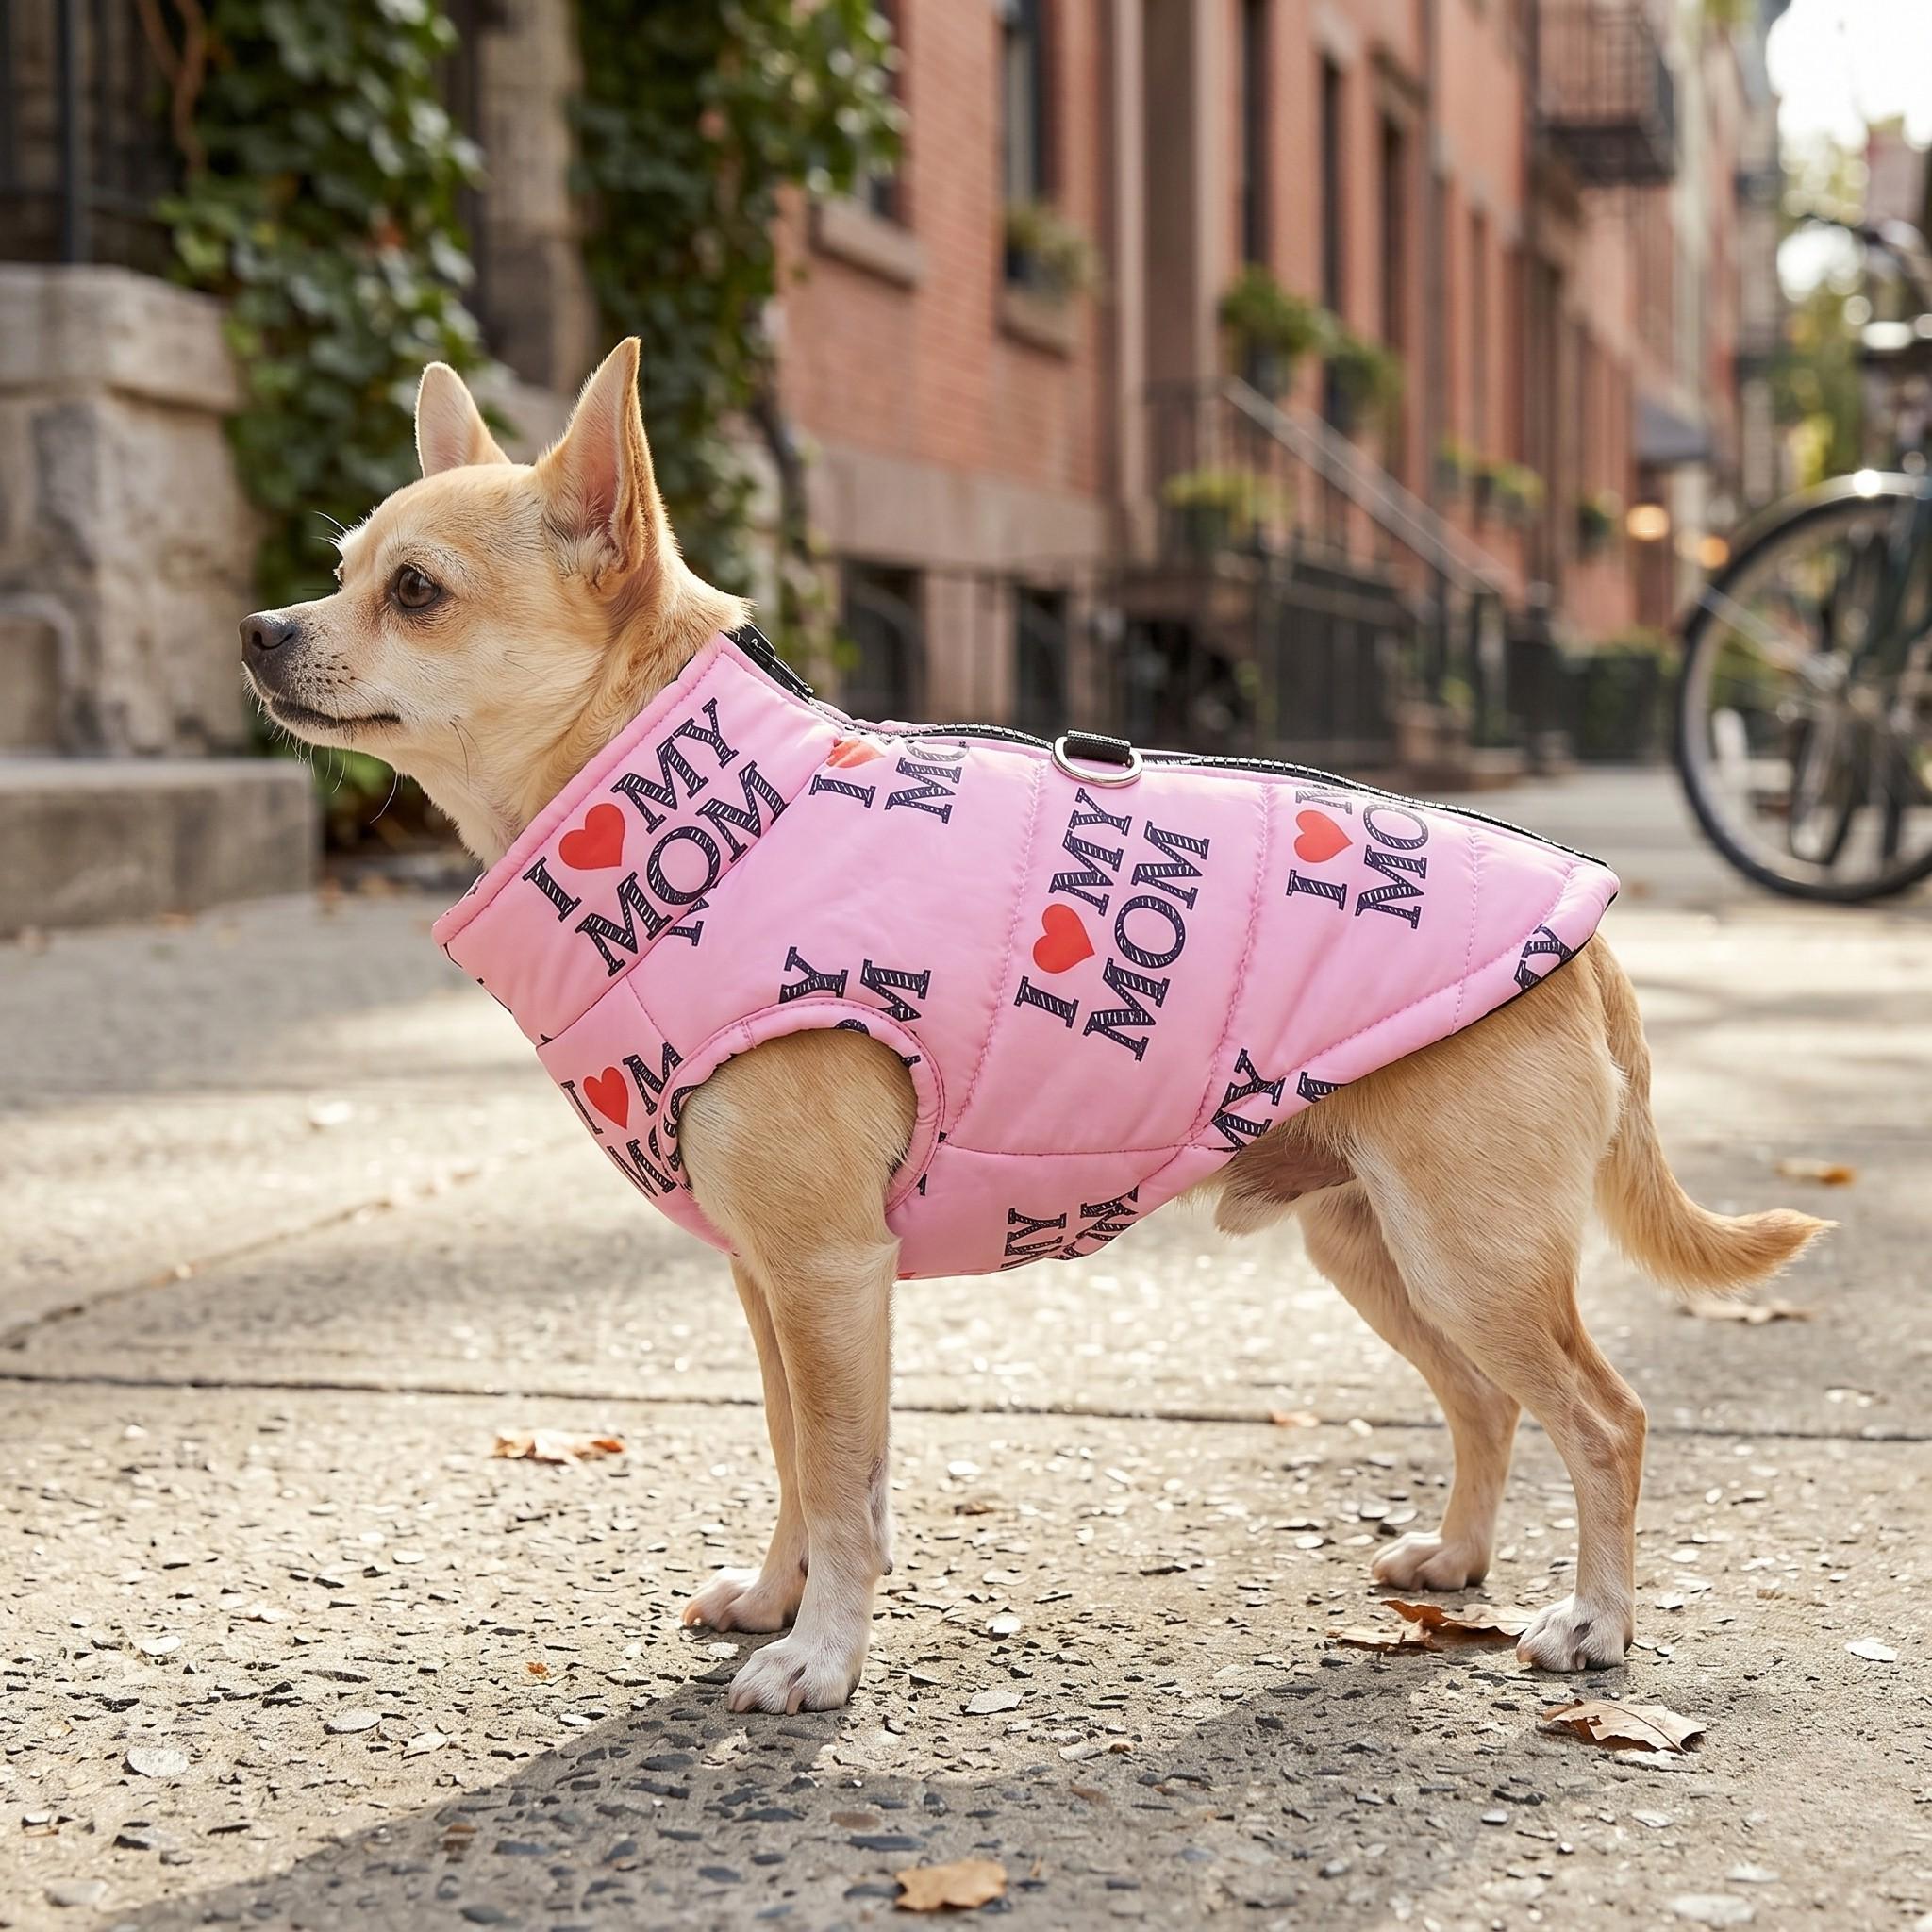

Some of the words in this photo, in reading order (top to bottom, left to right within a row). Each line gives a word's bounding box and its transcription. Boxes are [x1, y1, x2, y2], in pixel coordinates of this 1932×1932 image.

[522, 856, 582, 923] I
[610, 697, 740, 835] MY
[575, 760, 790, 977] MOM
[808, 774, 876, 808] I
[1286, 869, 1347, 910] I
[1014, 976, 1079, 1028] I
[1048, 788, 1132, 917] MY
[1083, 821, 1210, 1062] MOM
[561, 1080, 604, 1135] I
